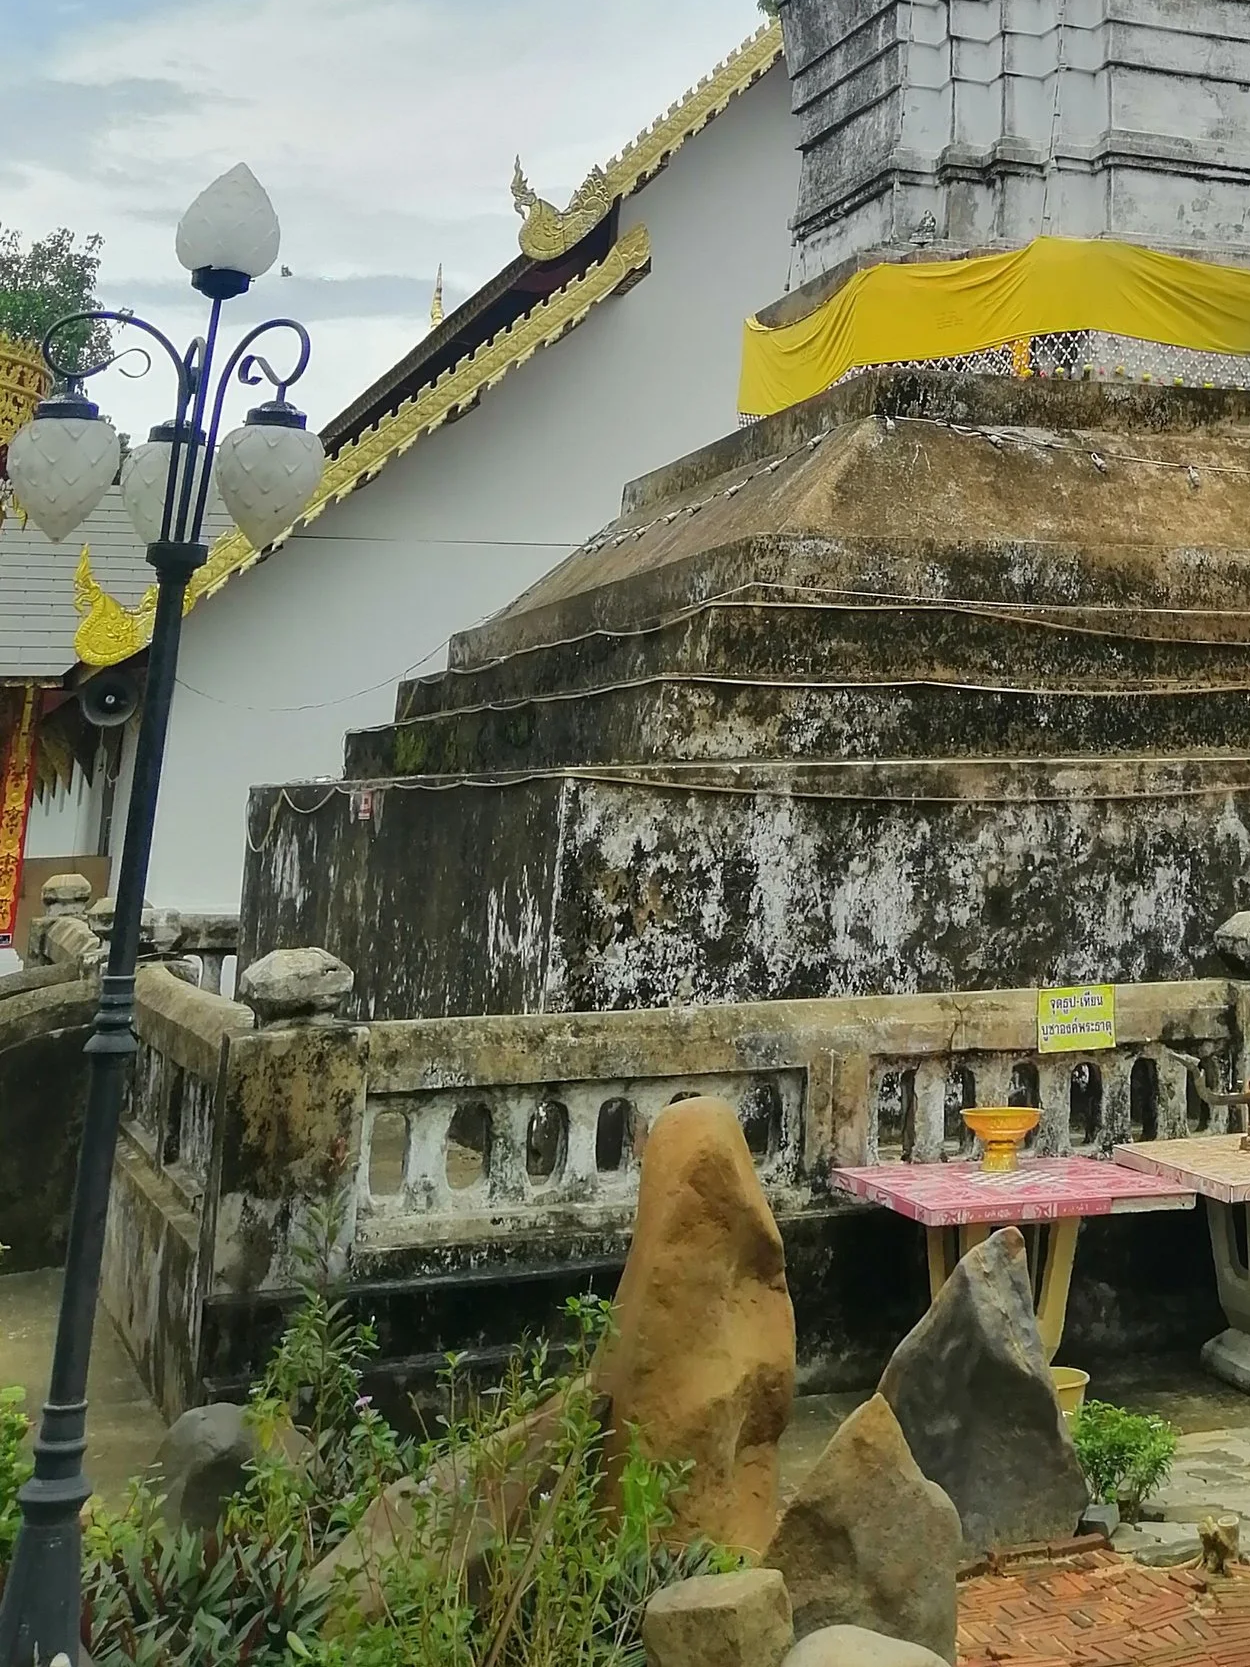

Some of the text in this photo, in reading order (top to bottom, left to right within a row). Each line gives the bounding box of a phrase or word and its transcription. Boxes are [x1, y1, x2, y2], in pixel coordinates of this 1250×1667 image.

[1041, 1017, 1112, 1041] บูชาองค์พระธาตุ
